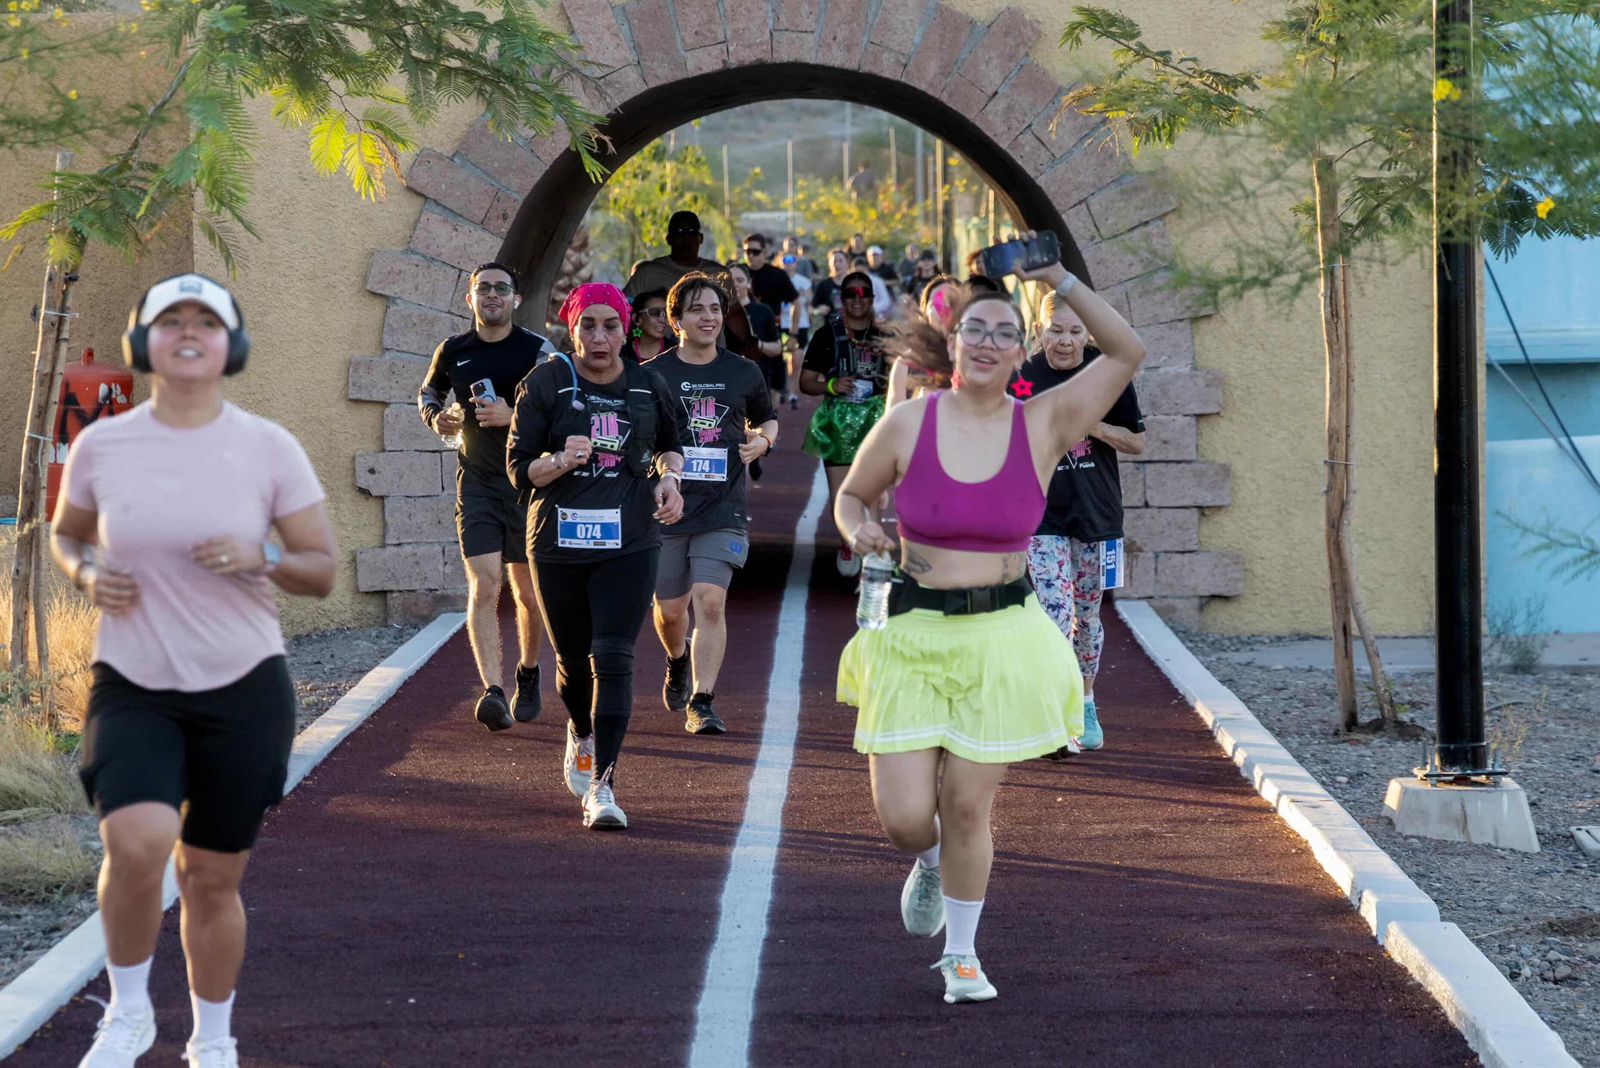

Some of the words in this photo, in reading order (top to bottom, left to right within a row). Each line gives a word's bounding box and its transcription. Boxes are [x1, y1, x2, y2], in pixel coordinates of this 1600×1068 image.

[691, 459, 710, 472] 174
[576, 523, 602, 539] 074
[1106, 548, 1116, 570] 151
